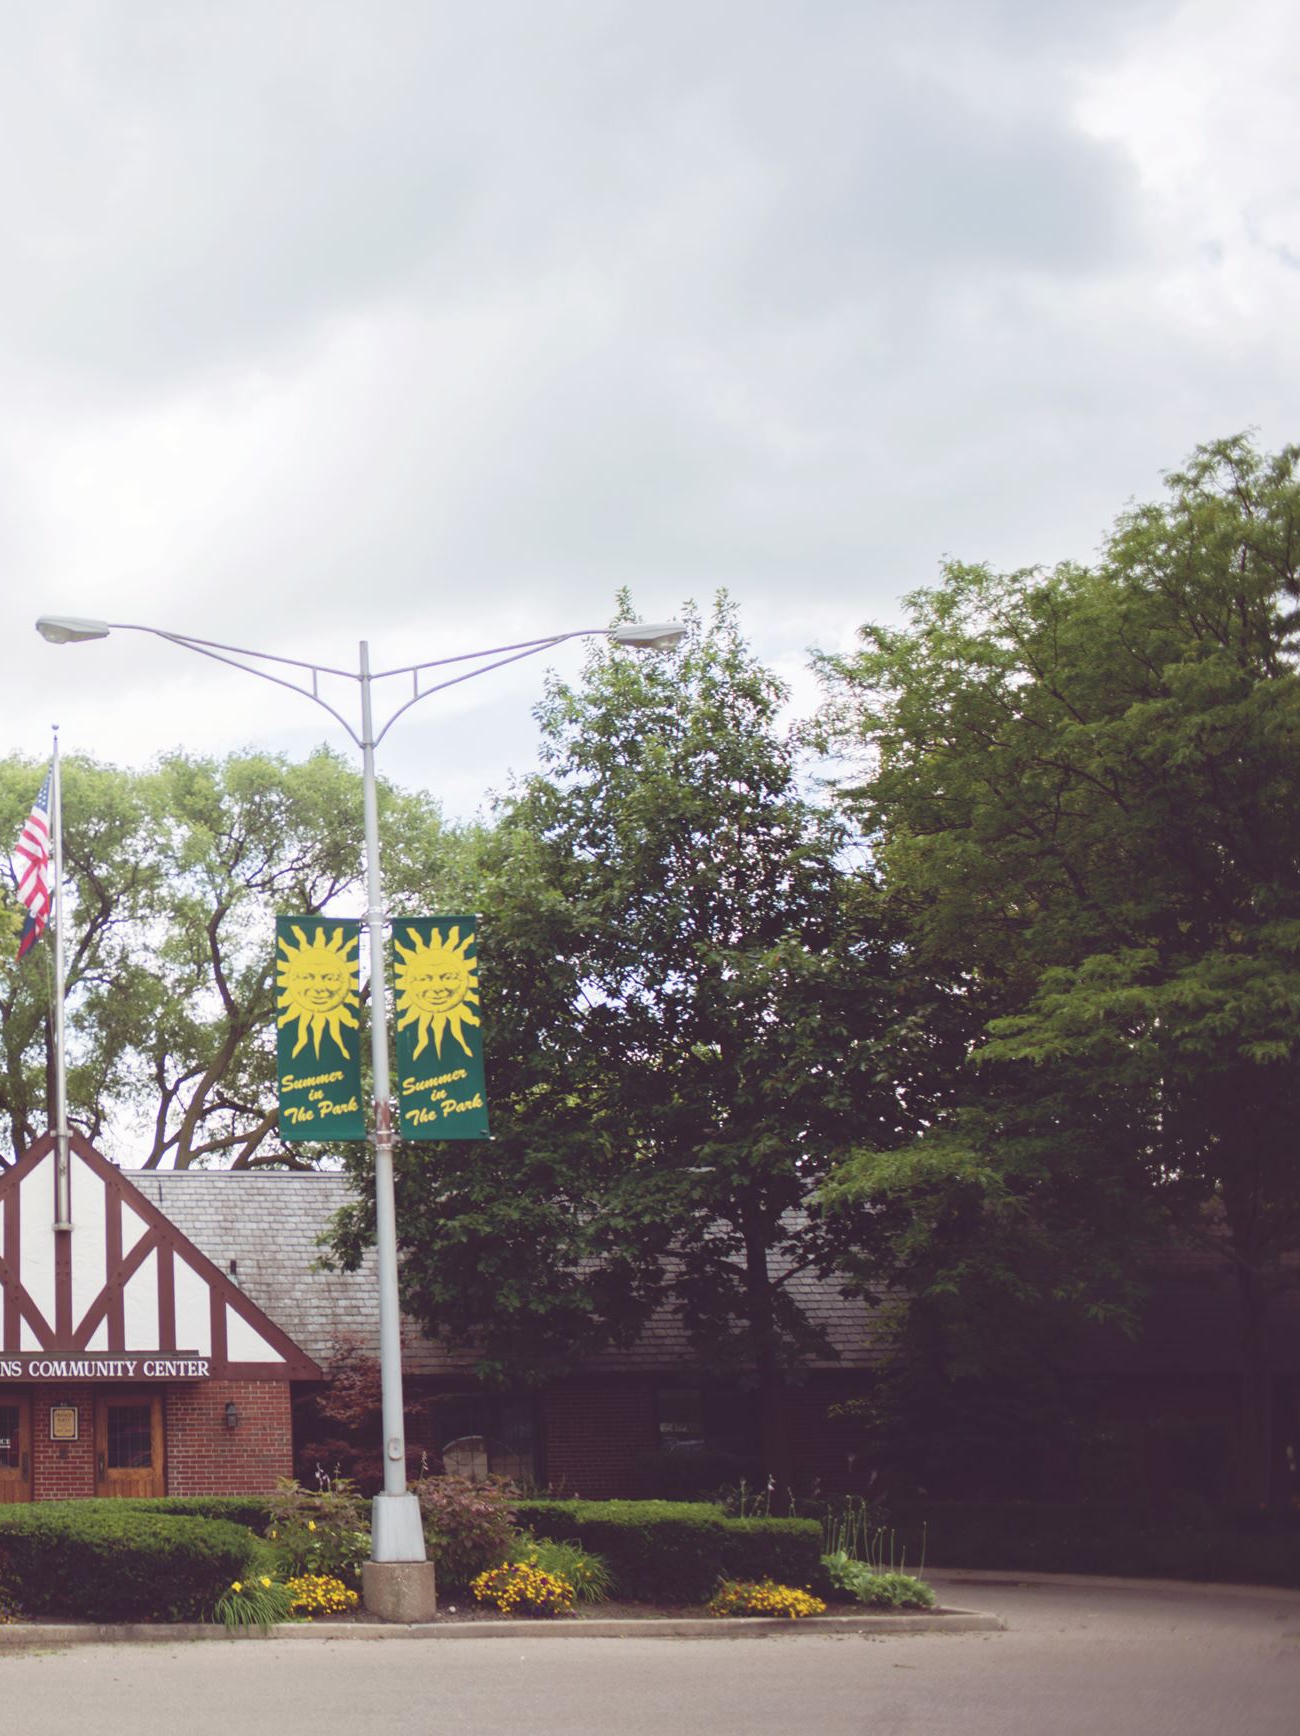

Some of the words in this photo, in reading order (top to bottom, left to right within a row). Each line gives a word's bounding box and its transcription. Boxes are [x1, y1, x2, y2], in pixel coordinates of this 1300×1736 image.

[281, 1071, 344, 1092] Summer
[402, 1069, 467, 1095] Summer
[308, 1089, 324, 1101] in
[431, 1089, 447, 1101] in
[284, 1106, 314, 1124] The
[318, 1096, 358, 1118] Park
[405, 1107, 437, 1126] The
[441, 1093, 483, 1117] Park
[28, 1361, 138, 1377] COMMUNITY
[143, 1361, 210, 1377] CENTER
